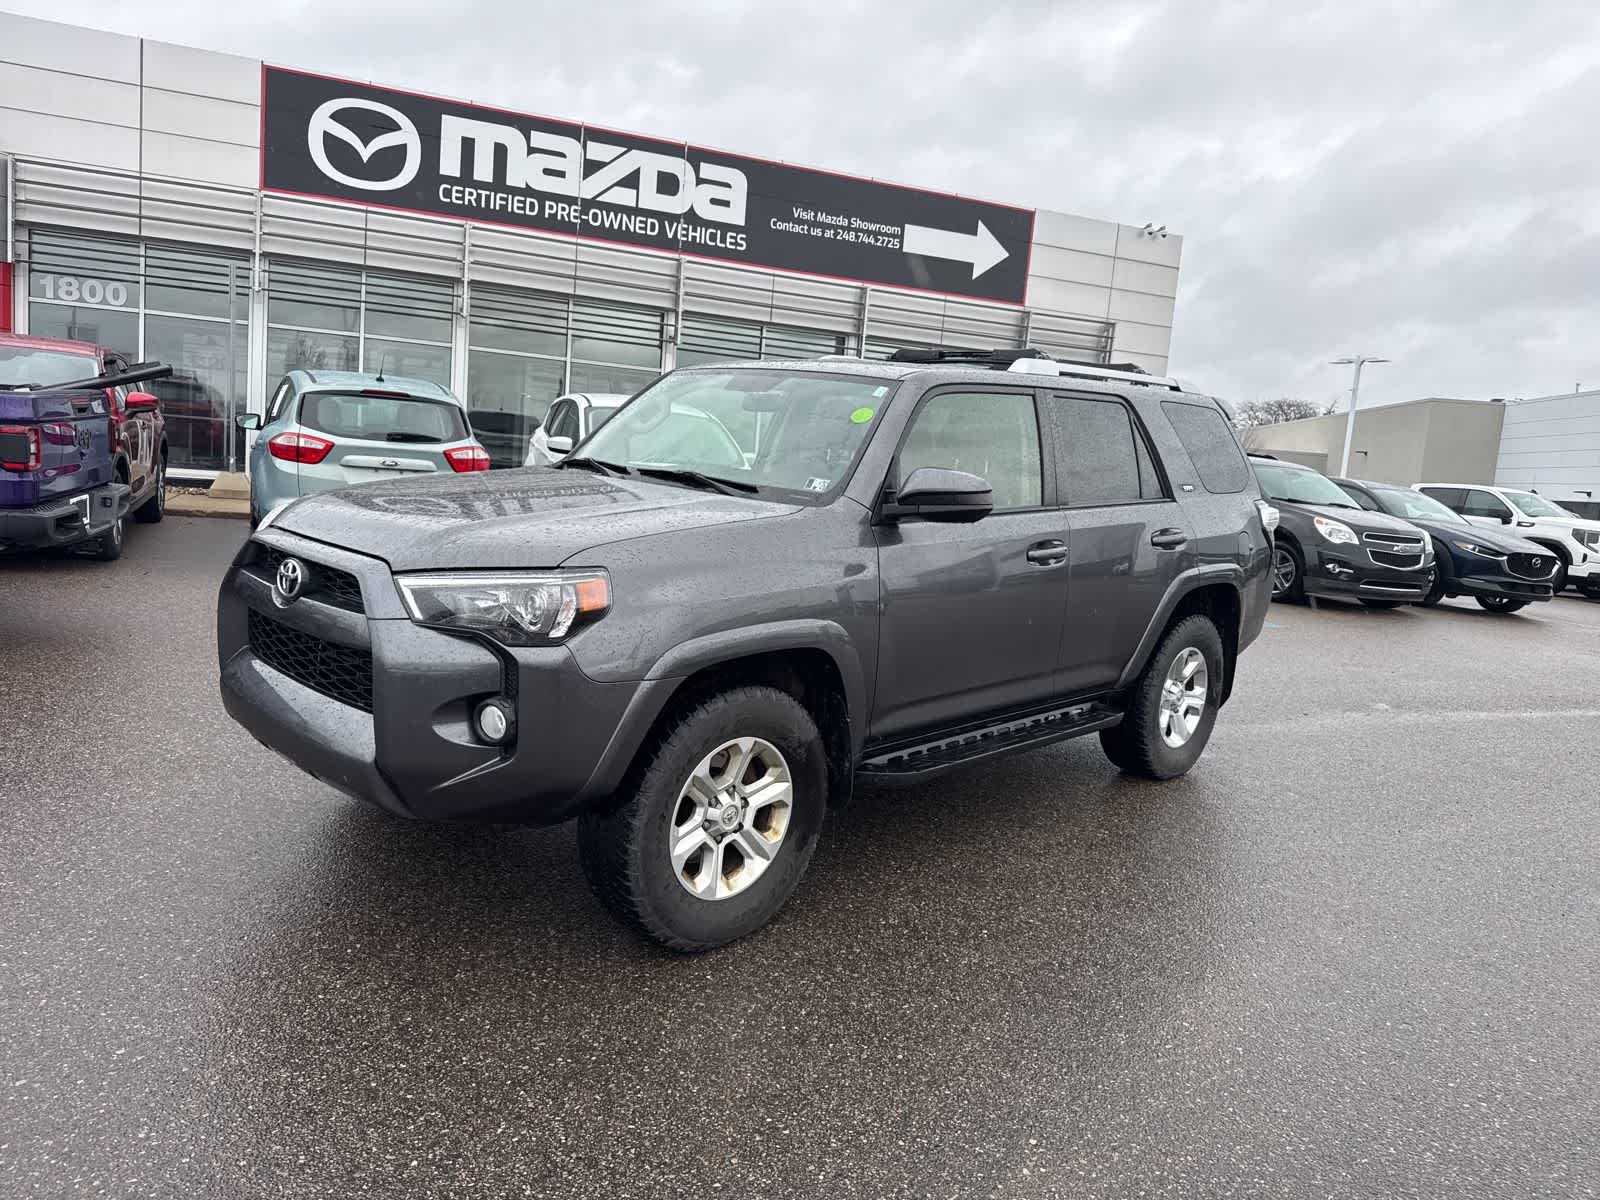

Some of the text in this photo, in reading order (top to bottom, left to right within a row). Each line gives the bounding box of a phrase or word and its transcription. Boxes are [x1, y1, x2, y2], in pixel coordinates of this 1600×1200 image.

[439, 184, 747, 251] CERTIFIED PRE-OWNED VEHICLES
[792, 207, 901, 236] Visit Mazda Showroom
[770, 218, 900, 249] Contact us at 248.744.2725
[40, 274, 127, 306] 1800
